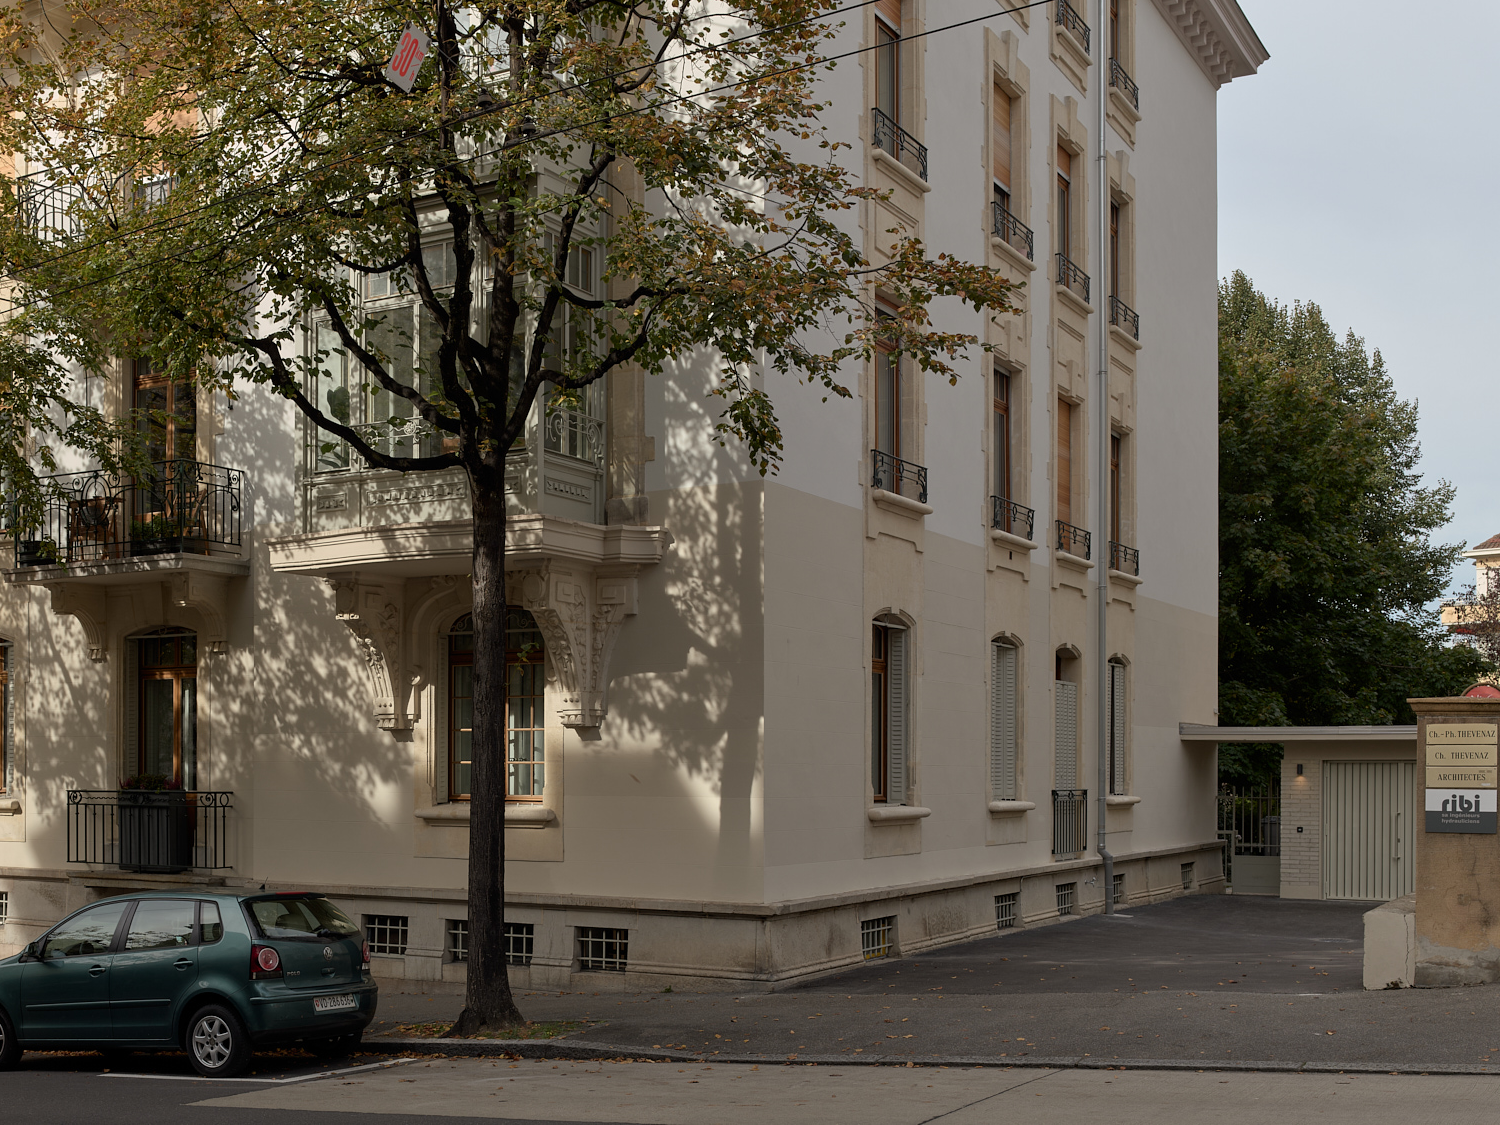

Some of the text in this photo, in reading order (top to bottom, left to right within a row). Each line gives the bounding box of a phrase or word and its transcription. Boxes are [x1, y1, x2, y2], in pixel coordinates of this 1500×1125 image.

[391, 32, 419, 77] 30
[1457, 730, 1495, 738] THEVENAZ
[1437, 773, 1486, 781] ARCHITECTES
[1441, 794, 1480, 812] ribi
